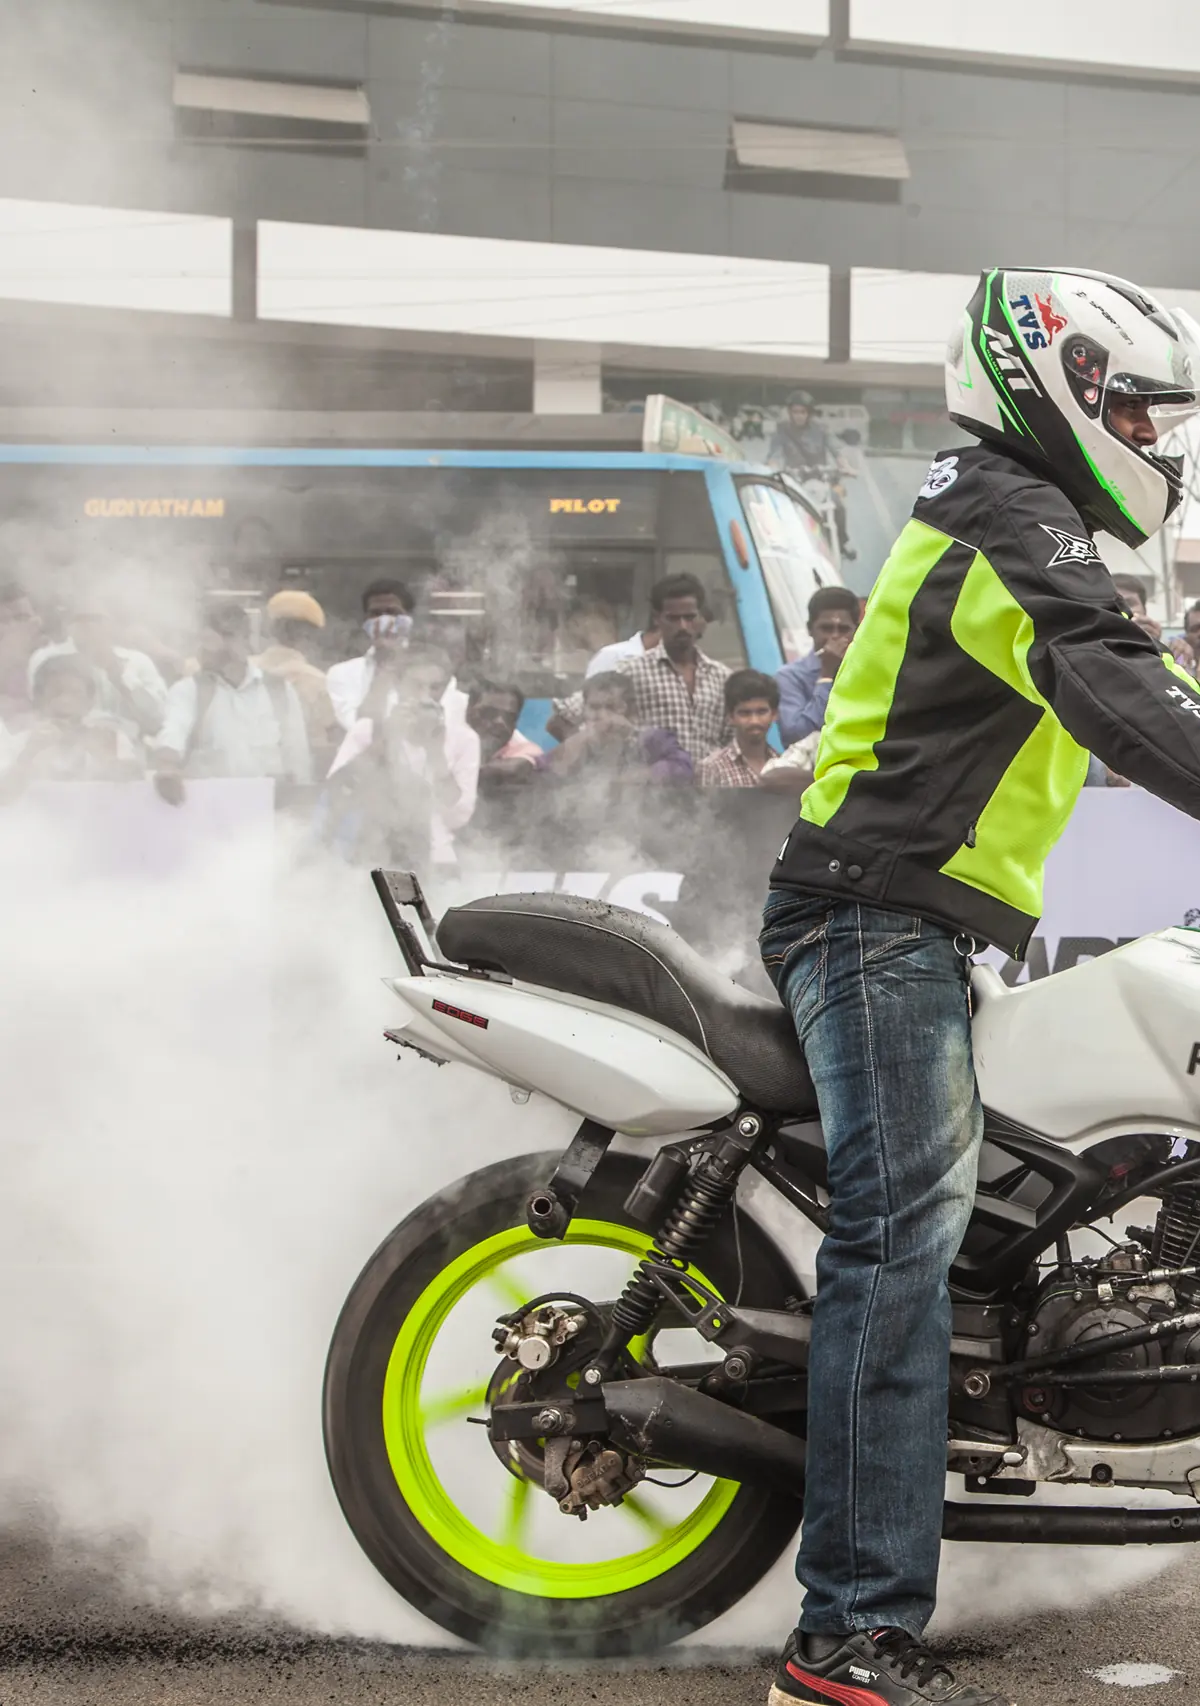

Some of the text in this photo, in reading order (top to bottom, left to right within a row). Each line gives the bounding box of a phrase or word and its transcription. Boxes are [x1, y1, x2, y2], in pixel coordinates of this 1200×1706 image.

[1009, 294, 1049, 350] TVS
[83, 498, 225, 518] GUDIYATHAM
[549, 498, 621, 514] PILOT
[434, 1001, 487, 1029] EDGE
